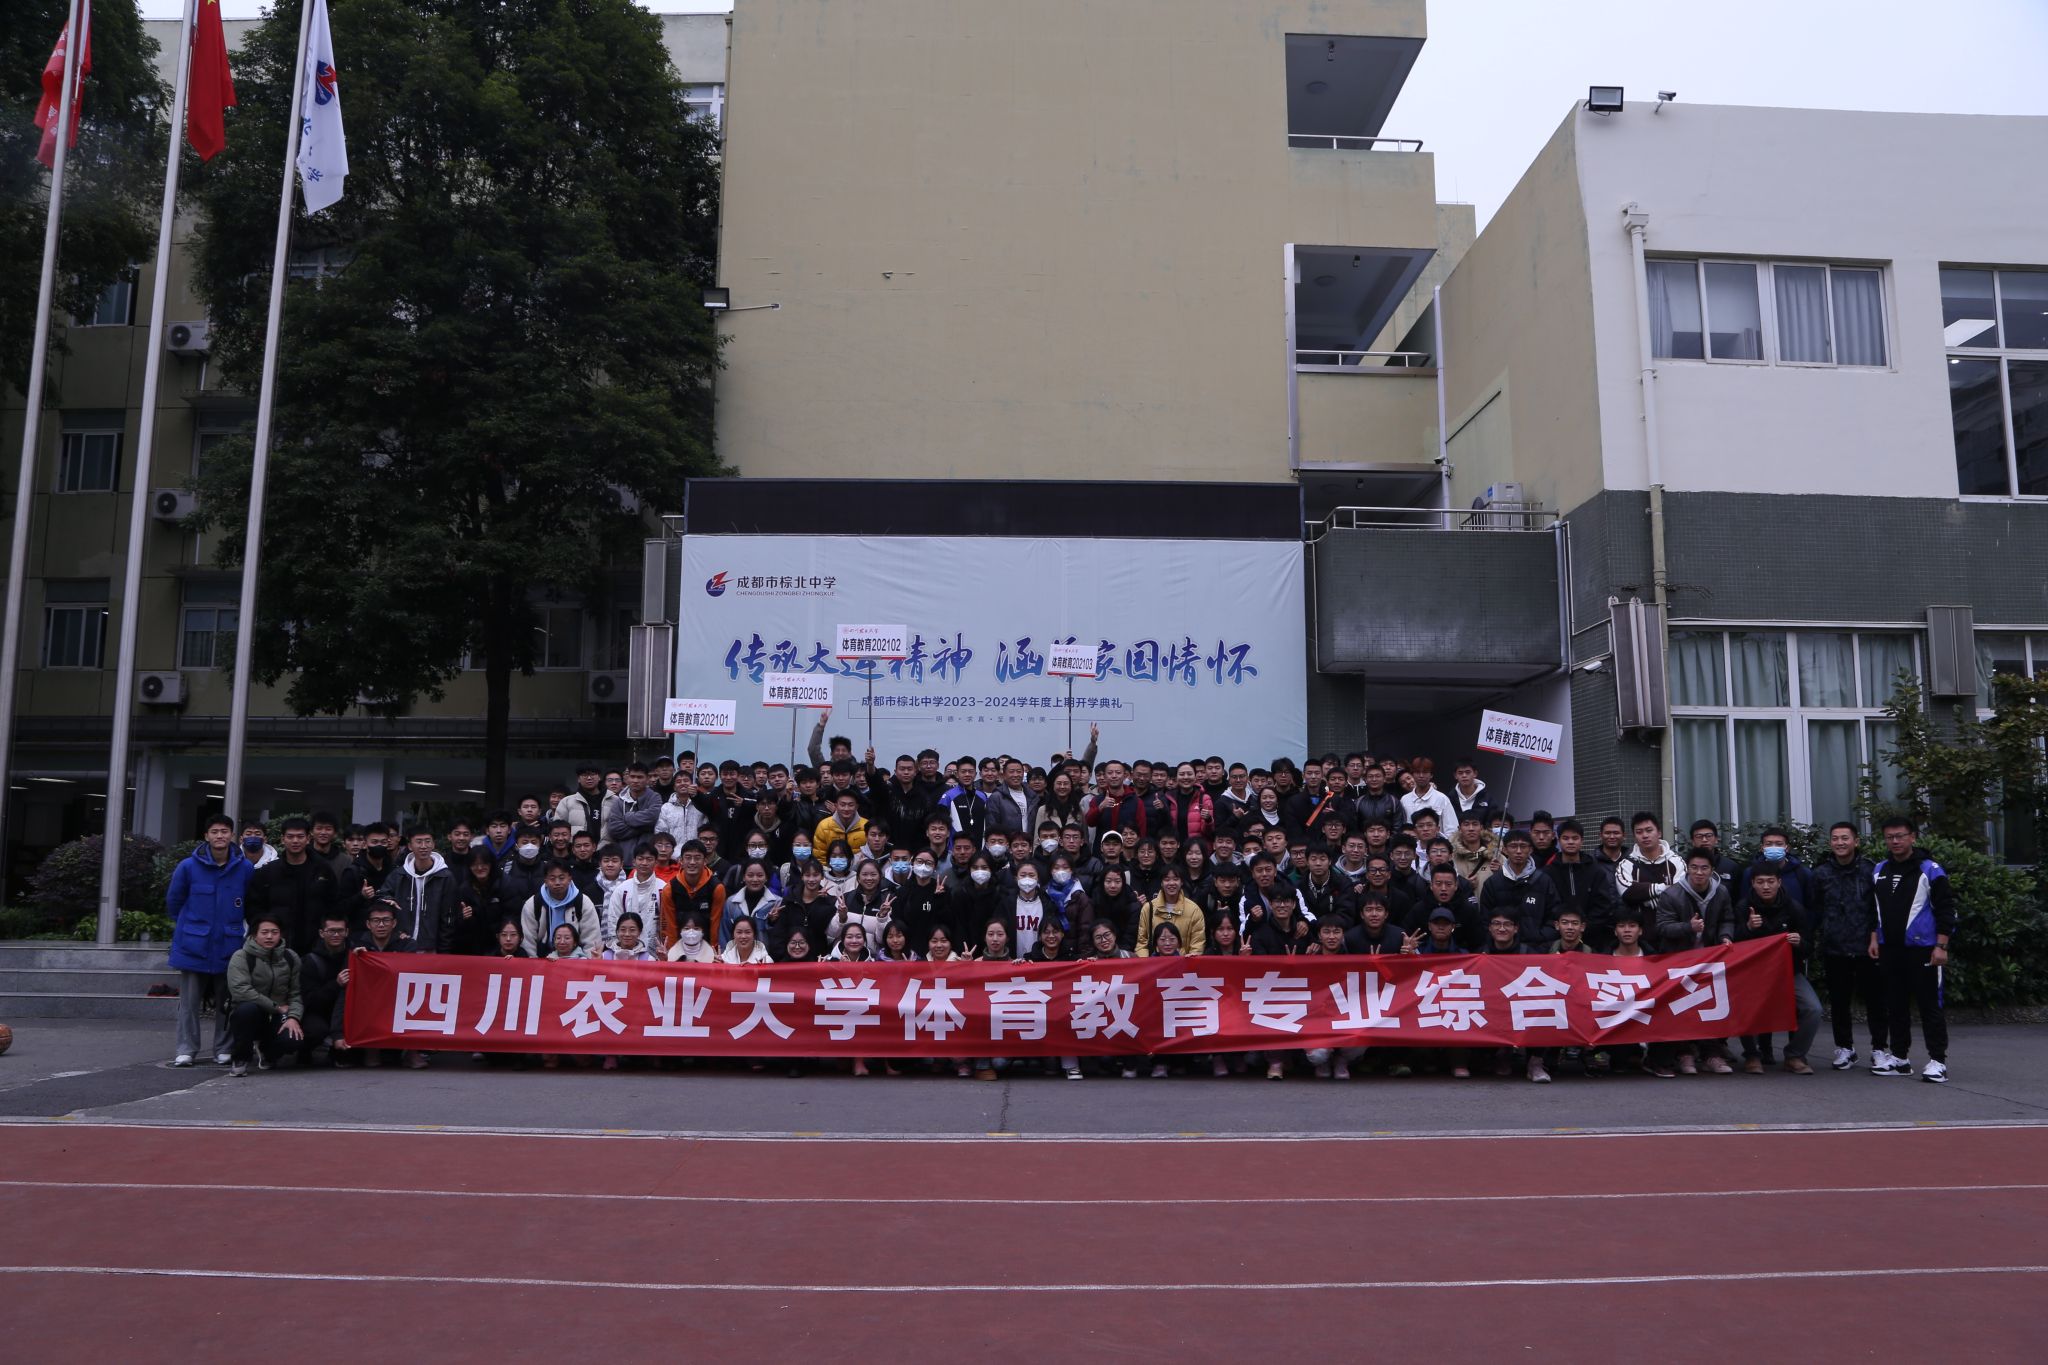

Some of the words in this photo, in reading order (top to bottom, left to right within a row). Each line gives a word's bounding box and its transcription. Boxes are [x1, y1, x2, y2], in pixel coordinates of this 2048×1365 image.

[736, 576, 836, 589] 成都市棕北中学
[842, 638, 901, 652] 体育教育202102
[995, 636, 1259, 687] 涵家国情怀
[1052, 656, 1093, 670] 体育教育202103
[769, 685, 828, 701] 体育教育202105
[670, 712, 728, 727] 体育教育202101
[1485, 726, 1553, 754] 体育教育202104
[392, 961, 1731, 1041] 四川农业大学体育教育专业综合实习
